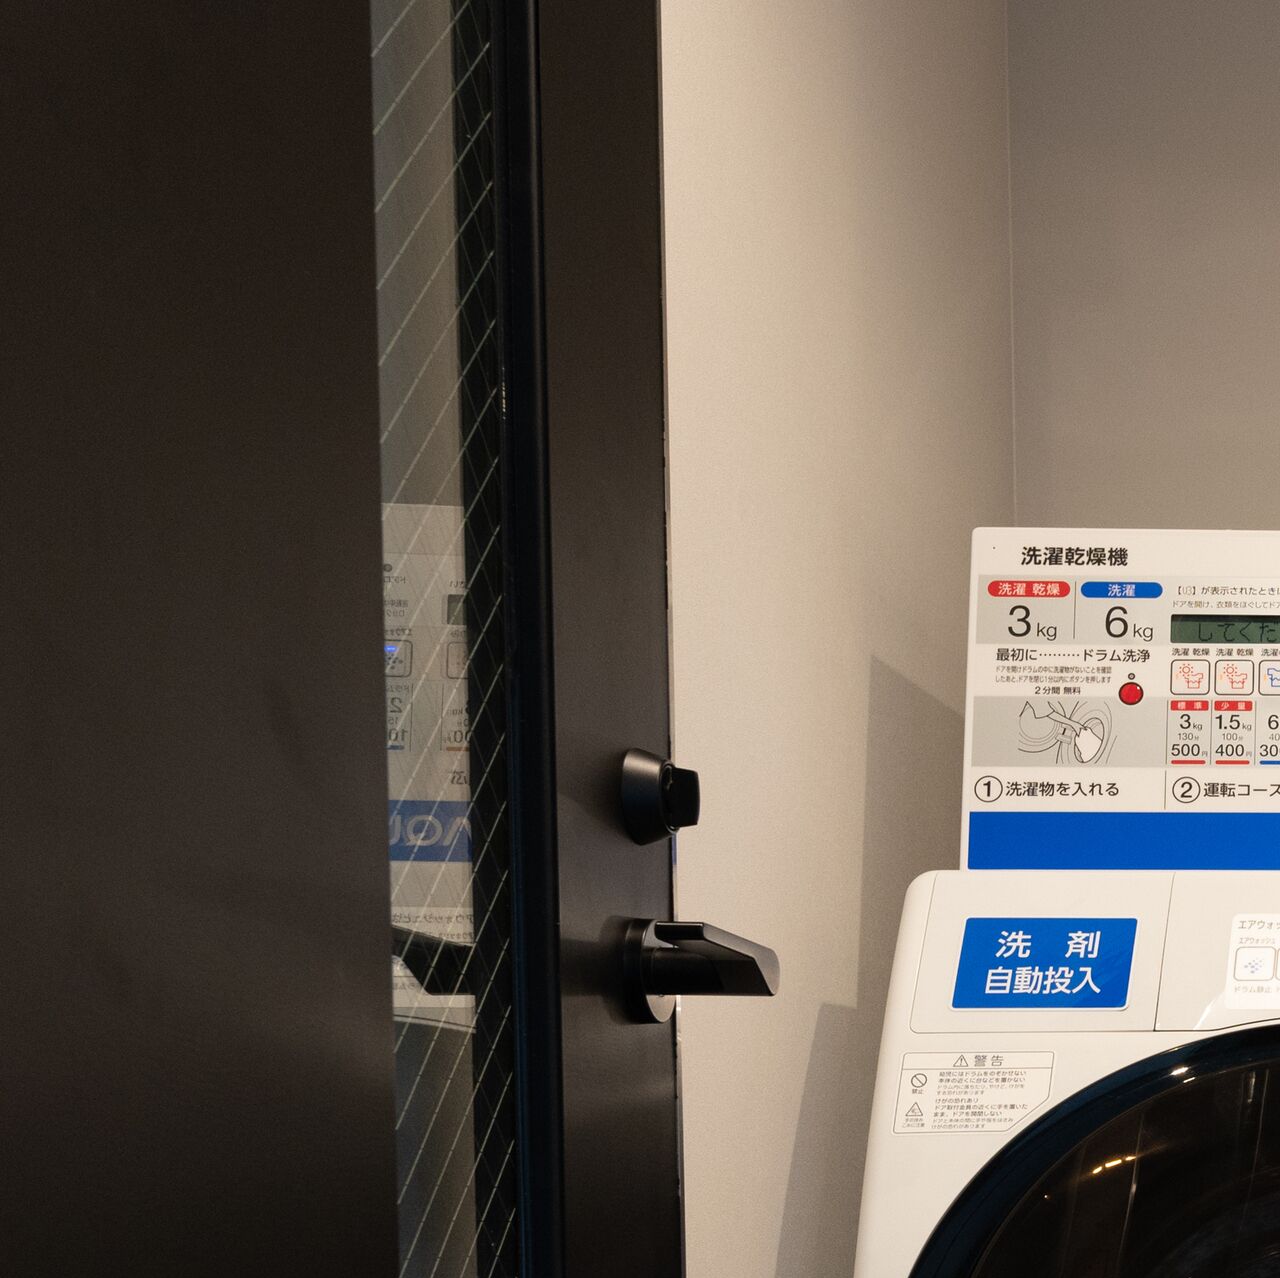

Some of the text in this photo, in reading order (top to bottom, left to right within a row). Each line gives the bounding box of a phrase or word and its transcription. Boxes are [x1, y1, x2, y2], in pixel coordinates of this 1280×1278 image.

[1021, 547, 1128, 567] 洗濯乾燥機
[998, 583, 1060, 596] 洗濯 乾燥
[1108, 584, 1136, 597] 洗濯
[1064, 687, 1081, 695] 無料
[985, 967, 1101, 994] 自動投入
